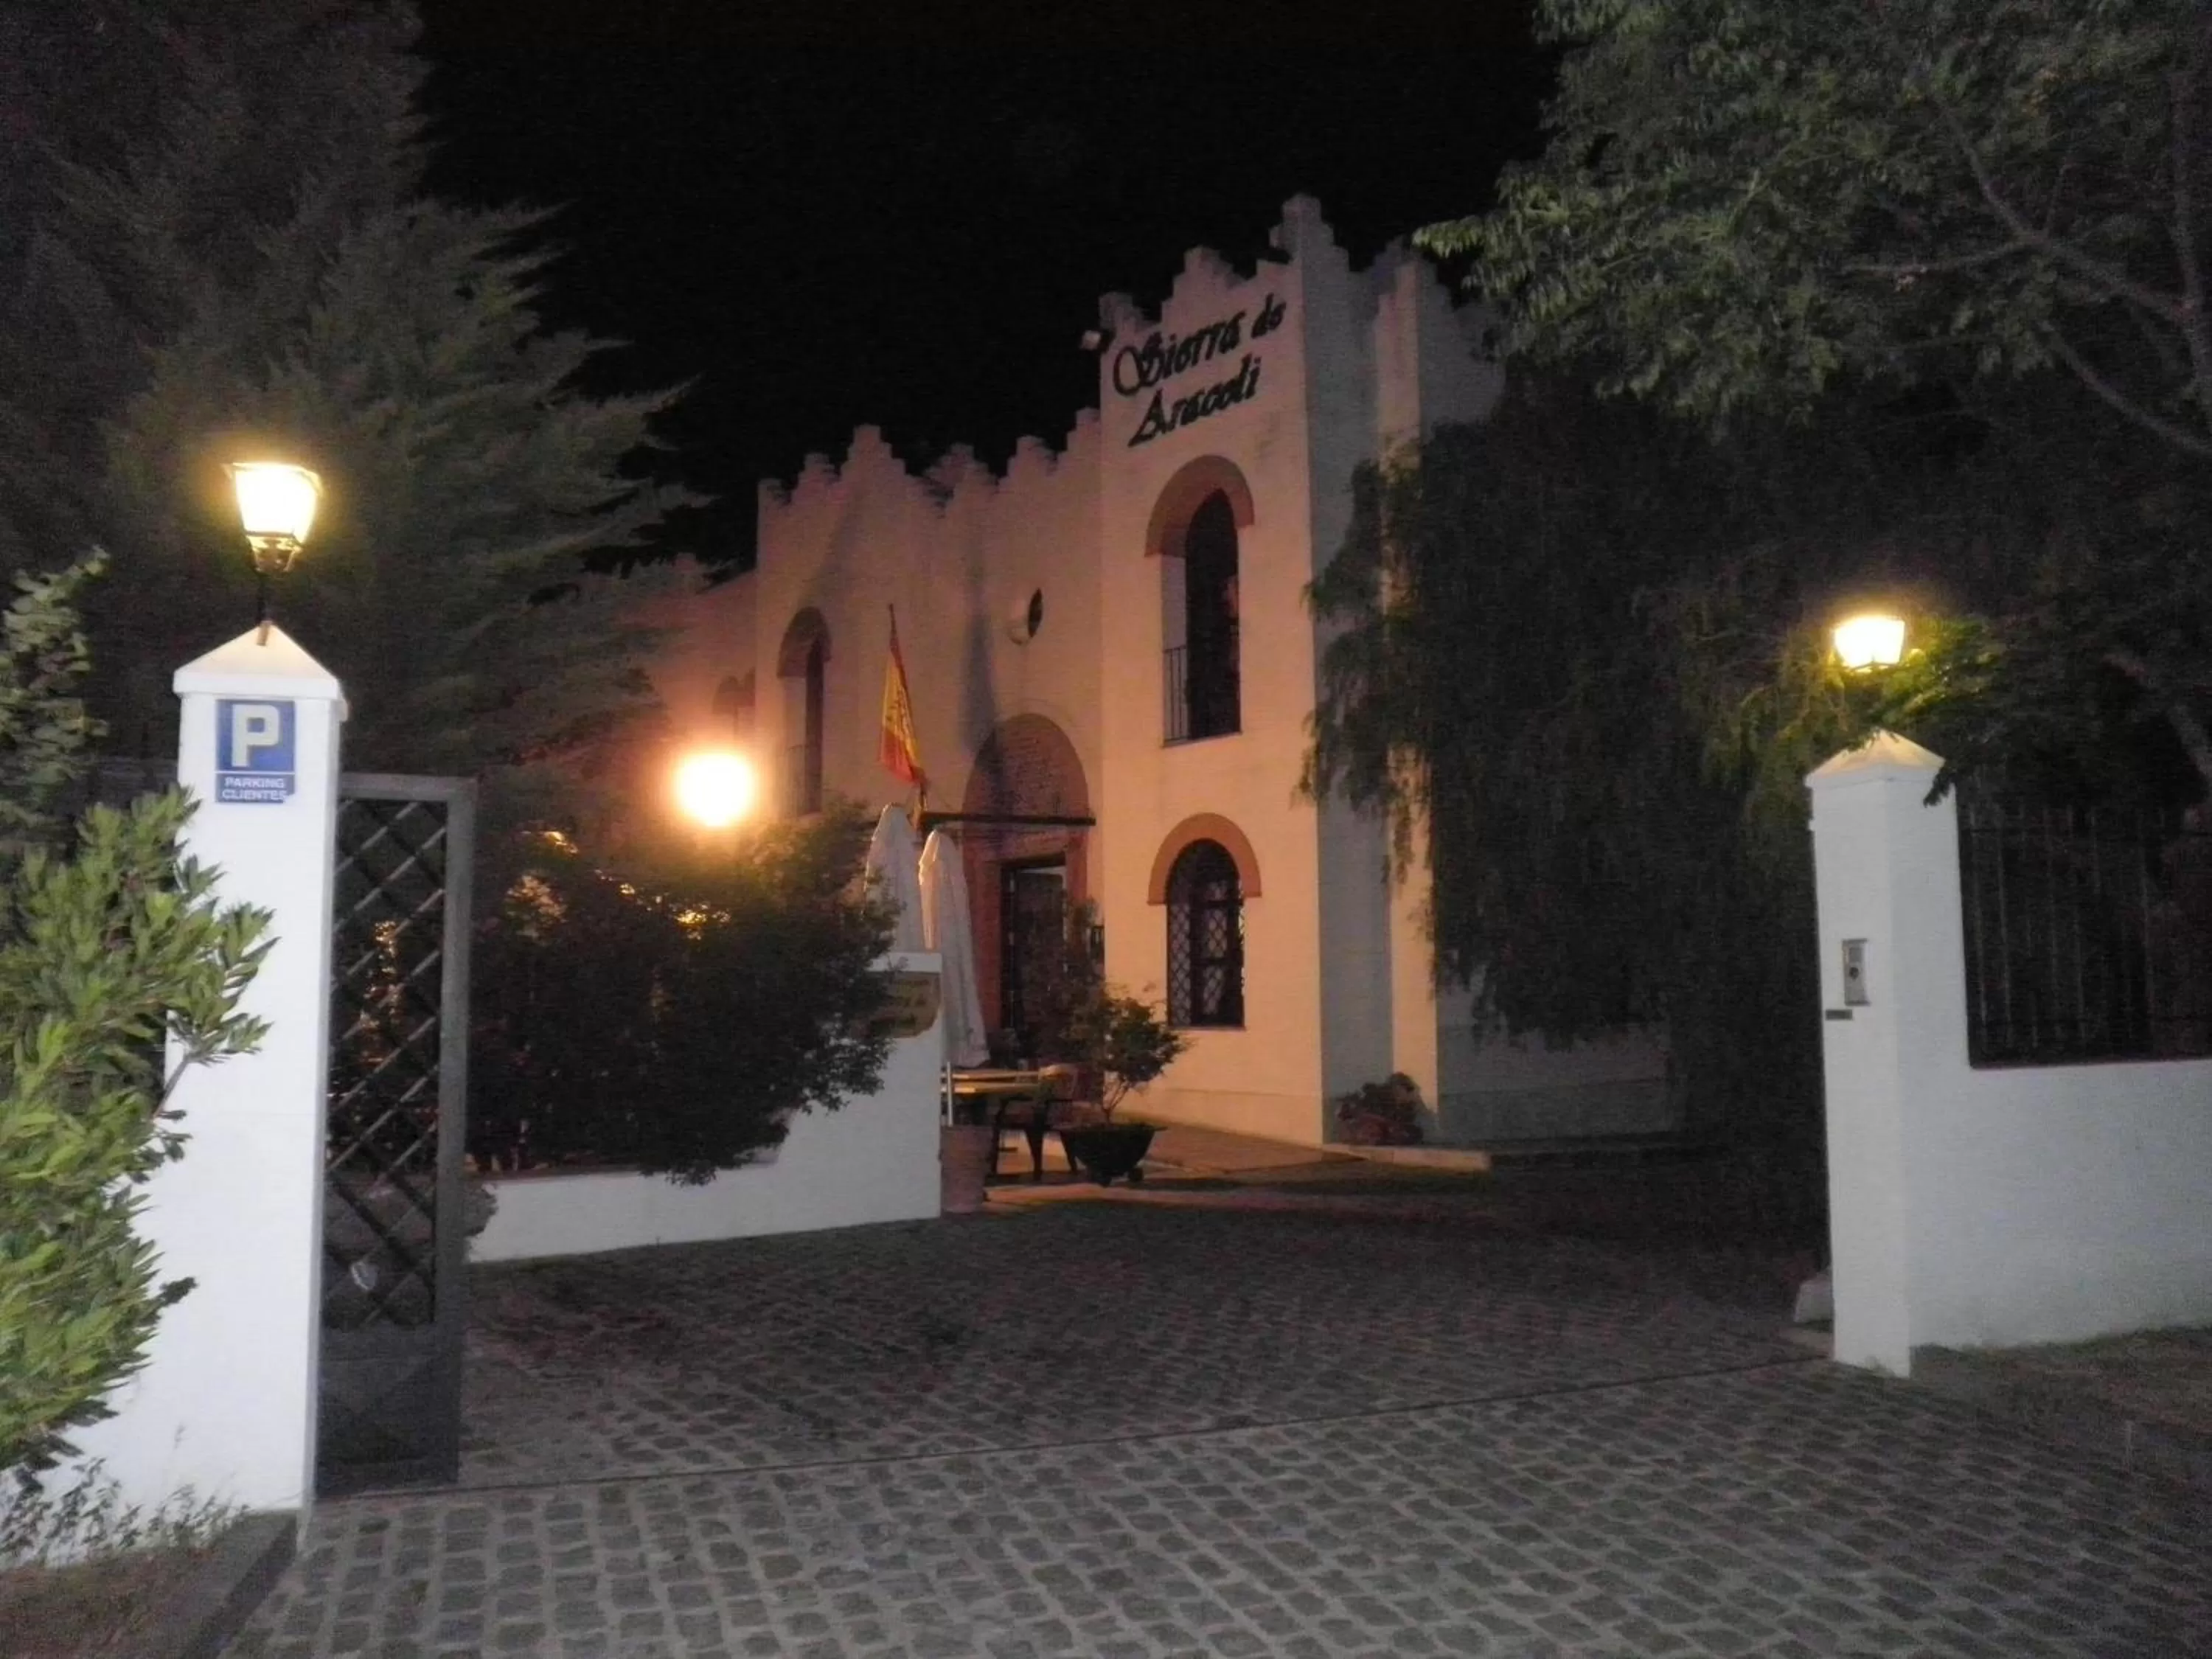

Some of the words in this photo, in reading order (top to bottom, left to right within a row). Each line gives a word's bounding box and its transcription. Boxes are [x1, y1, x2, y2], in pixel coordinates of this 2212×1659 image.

[1113, 309, 1246, 395] Sierra
[1251, 293, 1287, 339] de
[232, 704, 279, 768] P
[222, 789, 287, 801] CLIENTES
[224, 776, 285, 788] PARKING
